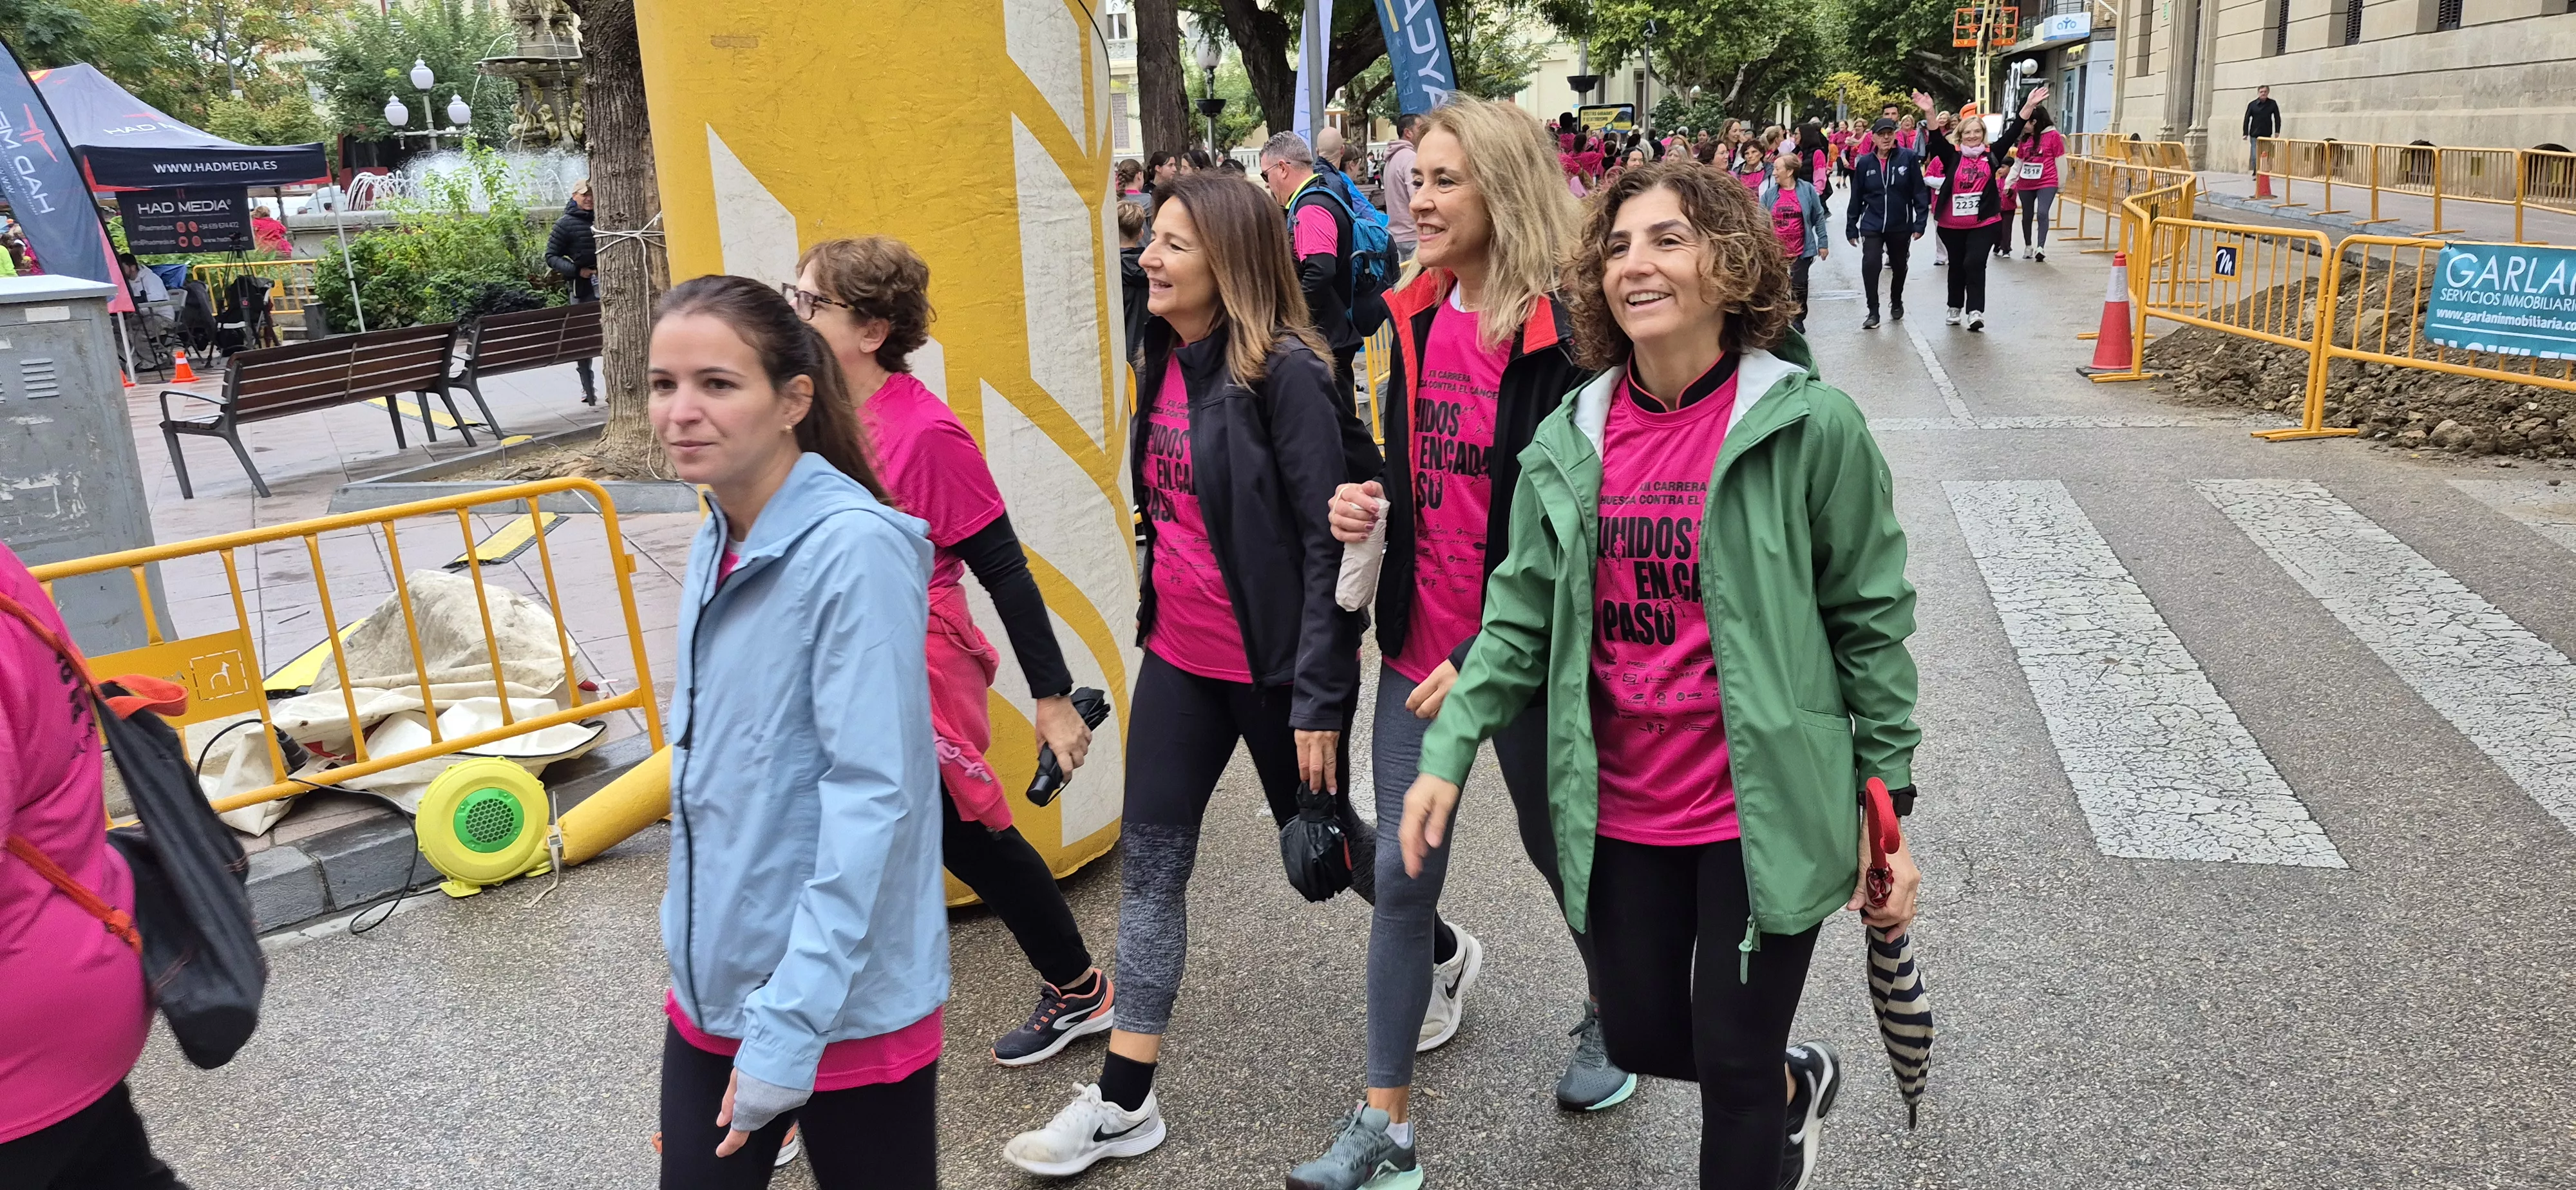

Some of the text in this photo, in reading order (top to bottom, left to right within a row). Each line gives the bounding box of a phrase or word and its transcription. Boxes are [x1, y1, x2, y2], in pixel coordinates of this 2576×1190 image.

[103, 124, 156, 135] HAD
[153, 161, 278, 173] WWW.HADMEDIA.ES
[137, 202, 175, 214] HAD
[1956, 200, 1980, 209] 2232
[2439, 288, 2576, 312] SERVICIOS INMOBILIARI
[1438, 370, 1470, 382] CARRERA
[1428, 380, 1457, 392] CONTRA
[1459, 385, 1467, 394] EL
[1654, 482, 1707, 492] CARRERA
[1600, 495, 1701, 505] HUESCA CONTRA EL
[1598, 516, 1692, 560] UNIDOS
[1634, 561, 1674, 600] EN
[1602, 600, 1675, 646] PASO
